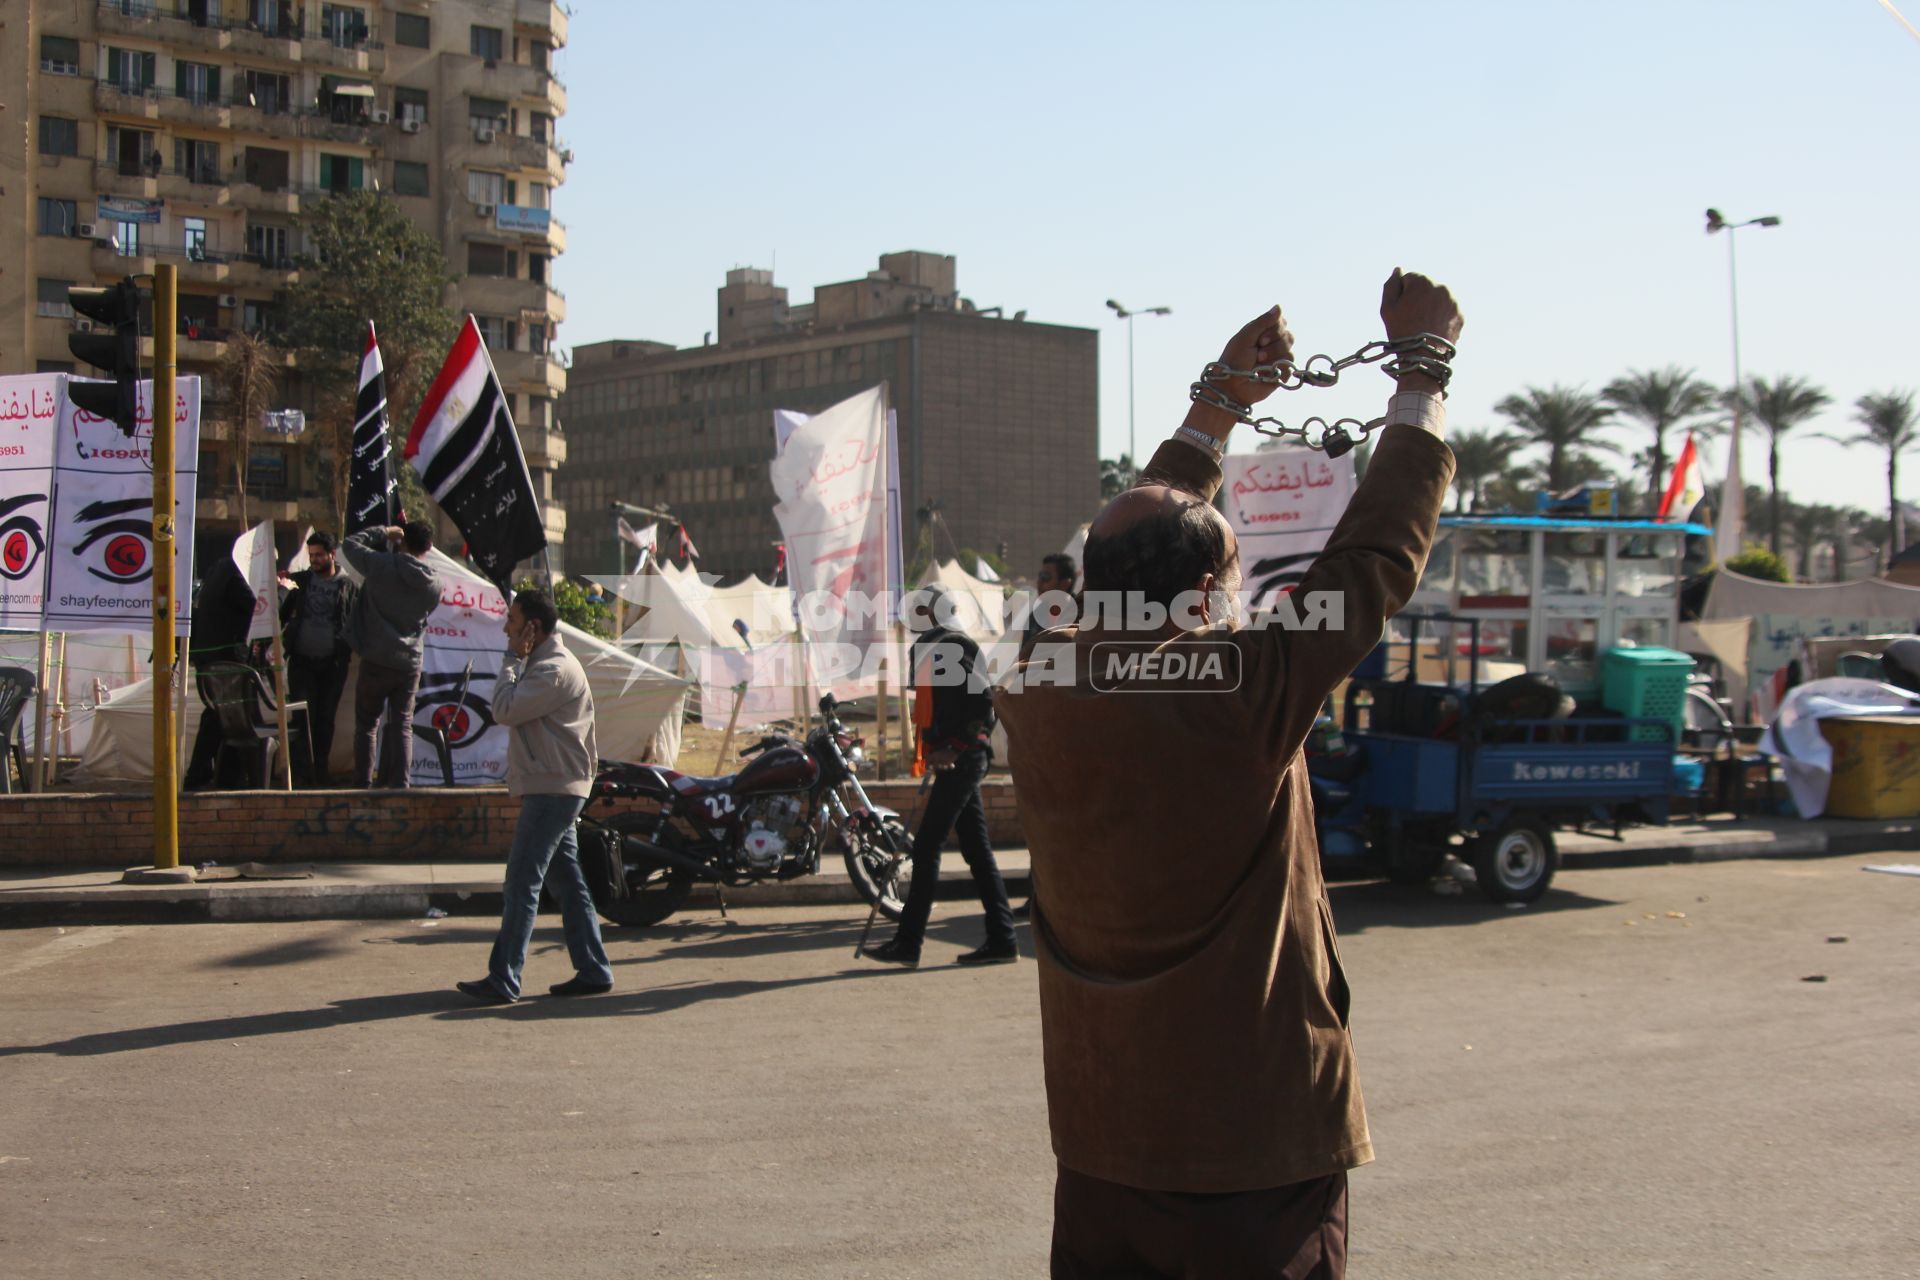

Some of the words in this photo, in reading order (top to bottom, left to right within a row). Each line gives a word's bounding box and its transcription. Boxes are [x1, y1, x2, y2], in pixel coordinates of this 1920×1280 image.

[0, 388, 55, 431] شايفن
[90, 448, 150, 459] 16951
[1232, 461, 1335, 511] شايفنكم
[440, 585, 506, 618] شايفن
[705, 793, 736, 819] 22
